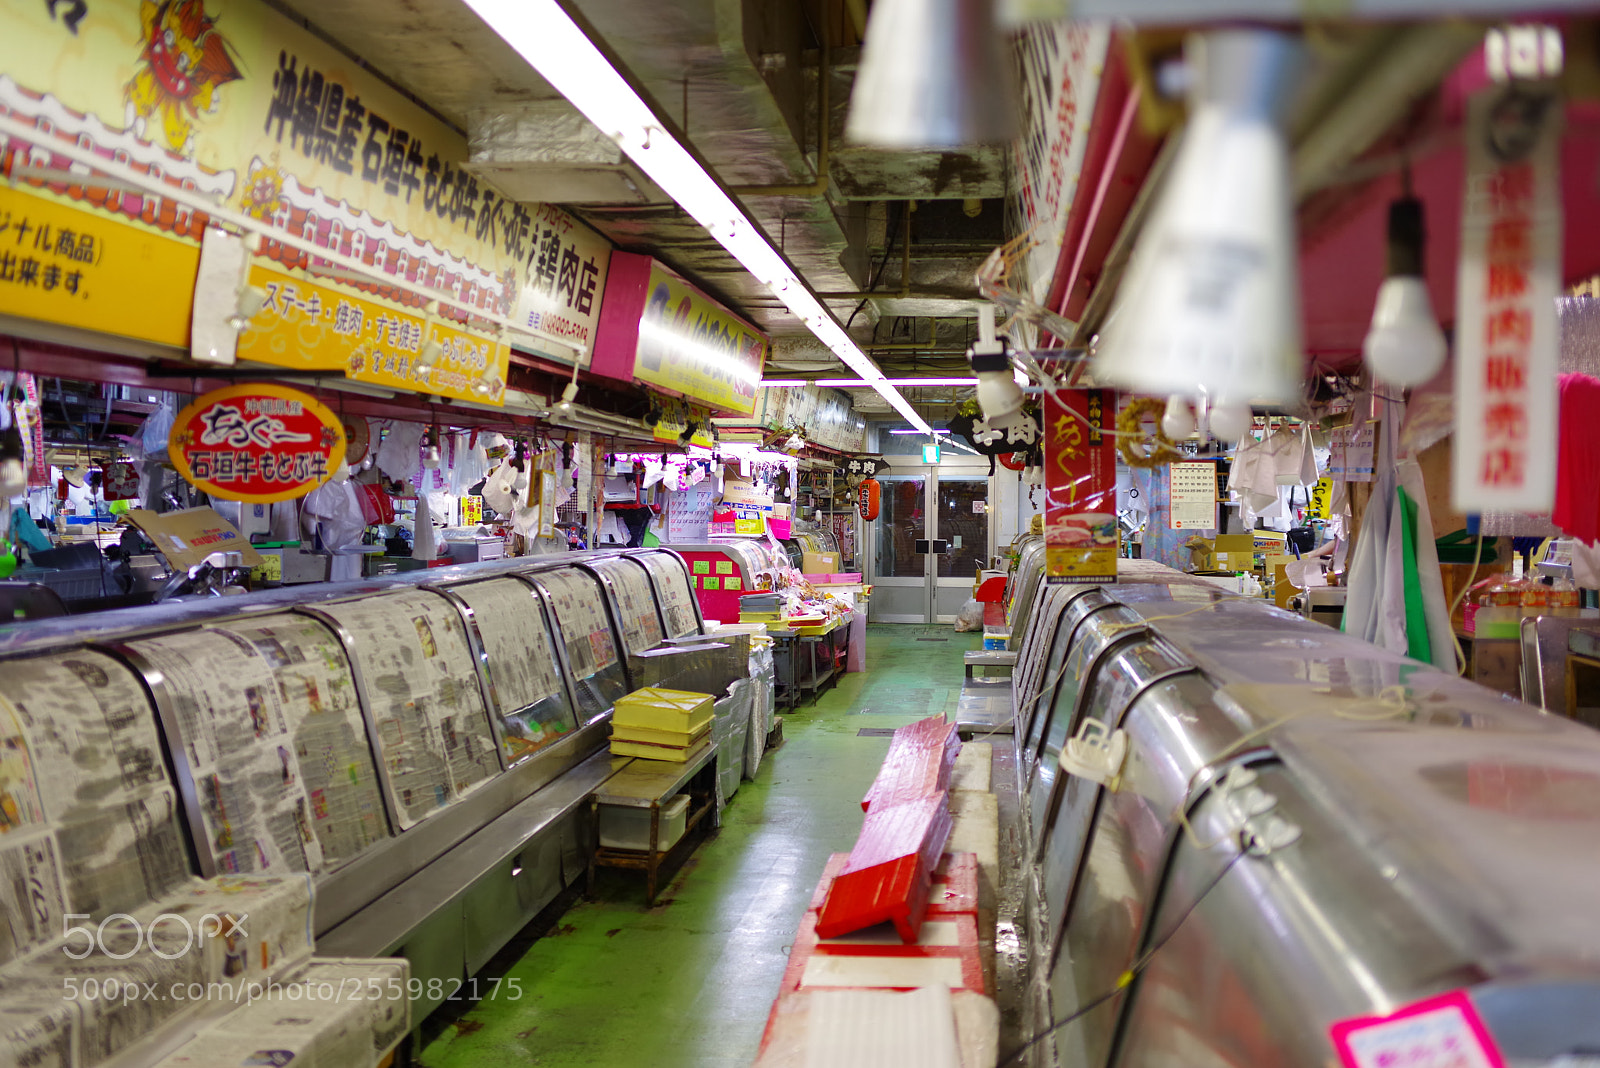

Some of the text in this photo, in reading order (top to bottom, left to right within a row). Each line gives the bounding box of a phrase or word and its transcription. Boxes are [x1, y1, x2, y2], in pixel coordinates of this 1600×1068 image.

[200, 403, 312, 448] あぐー
[848, 460, 876, 475] 牛肉
